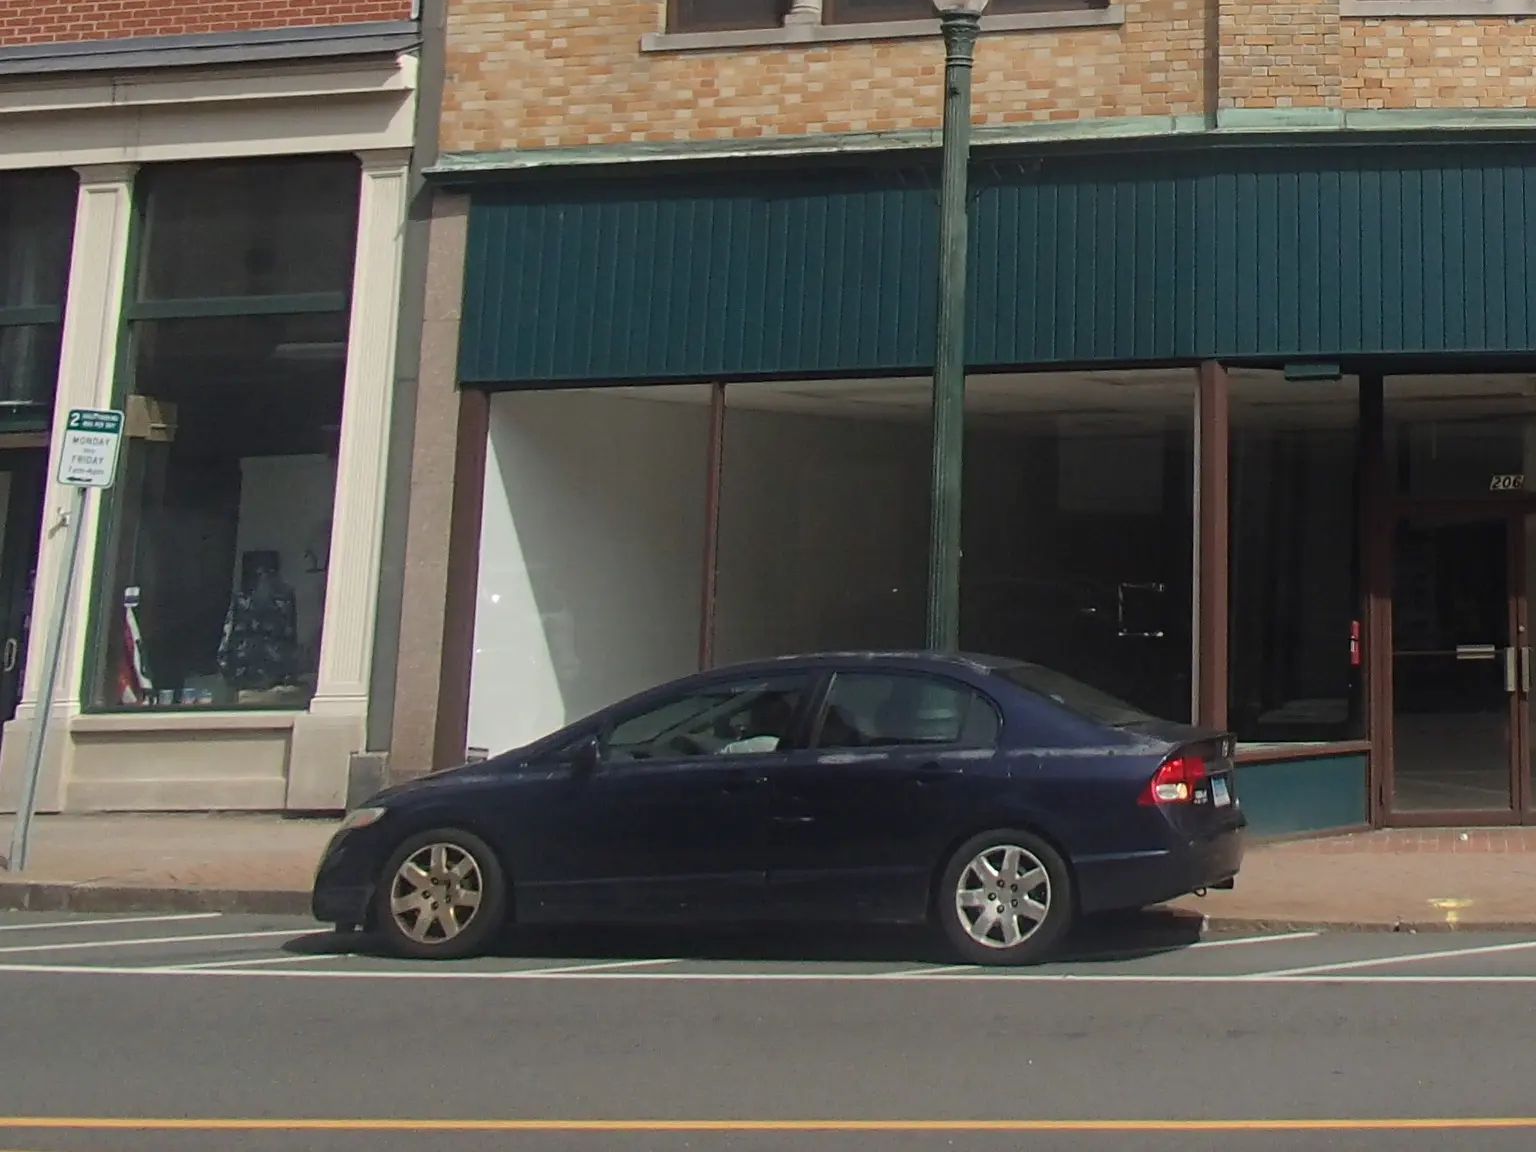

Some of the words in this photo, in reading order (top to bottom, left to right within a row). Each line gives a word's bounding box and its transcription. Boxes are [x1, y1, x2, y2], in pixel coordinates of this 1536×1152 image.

[70, 412, 80, 426] 2
[73, 436, 110, 446] MONDAY
[71, 454, 104, 465] FRIDAY
[1491, 476, 1522, 489] 206
